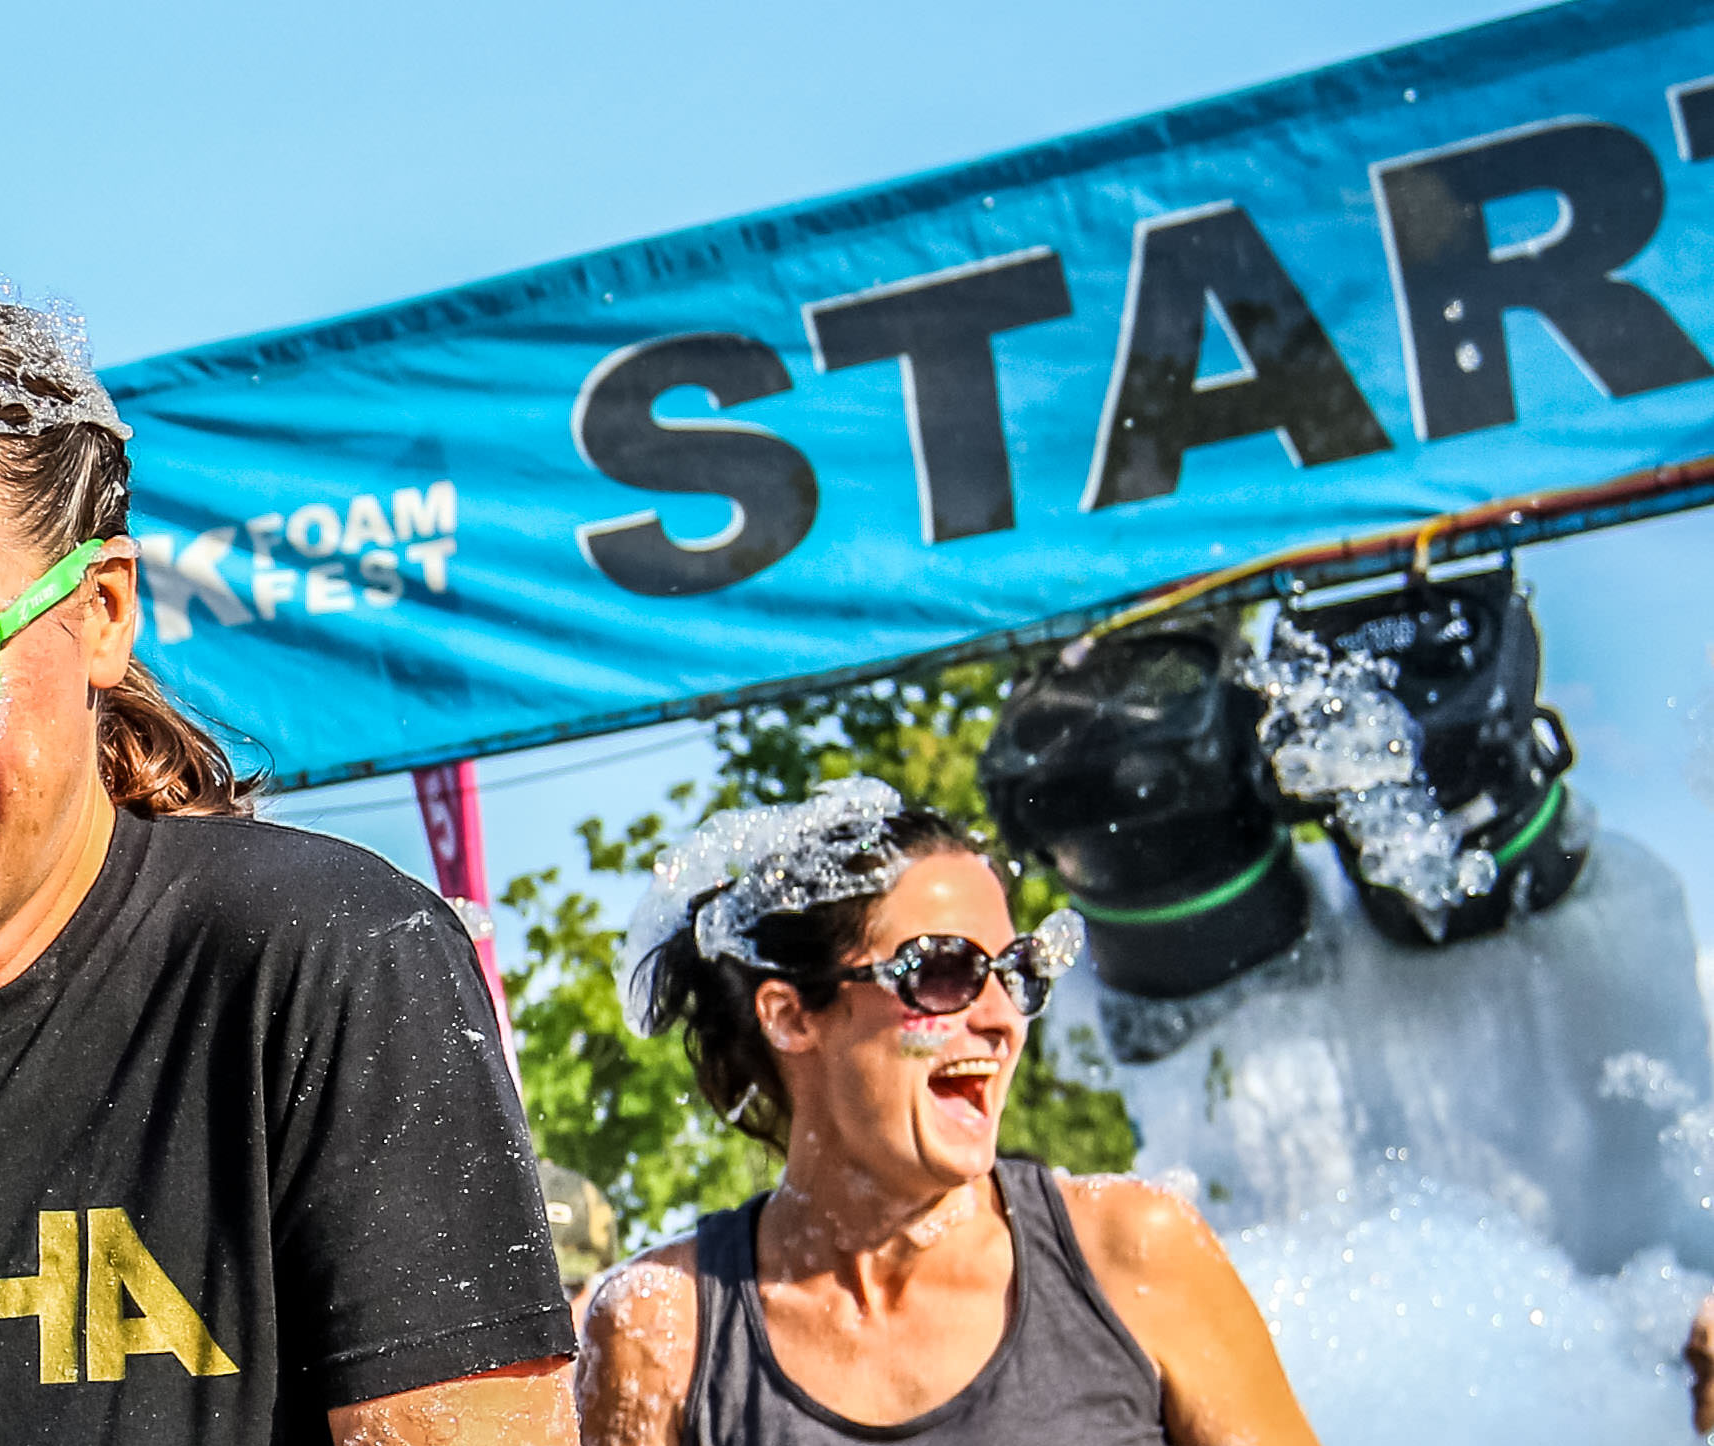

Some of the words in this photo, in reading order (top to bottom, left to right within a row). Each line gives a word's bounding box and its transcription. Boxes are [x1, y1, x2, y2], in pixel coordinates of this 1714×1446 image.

[571, 78, 1714, 596] STAR
[246, 480, 458, 570] FOAM
[135, 525, 254, 644] K
[252, 537, 458, 621] FEST
